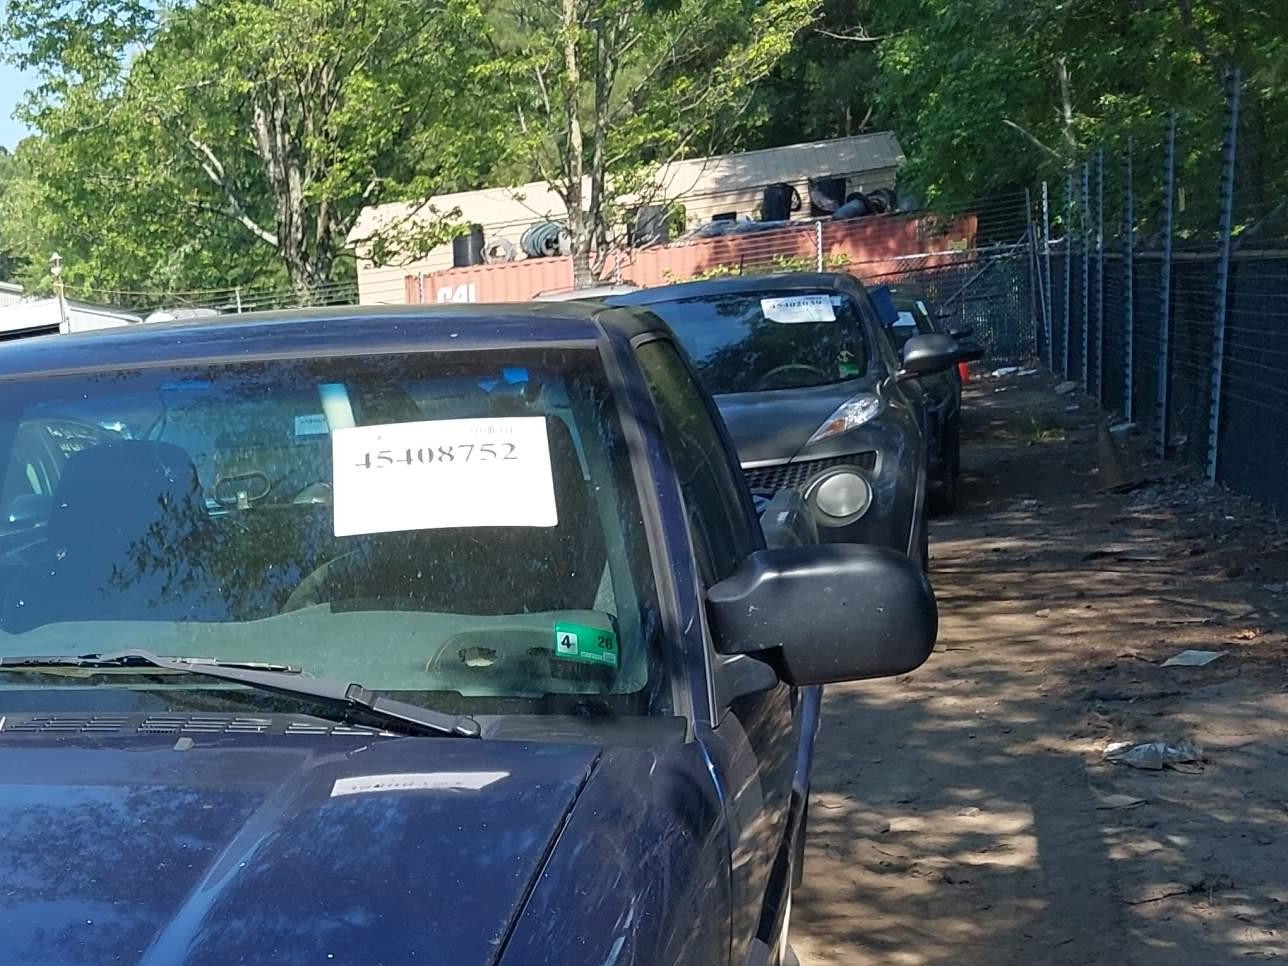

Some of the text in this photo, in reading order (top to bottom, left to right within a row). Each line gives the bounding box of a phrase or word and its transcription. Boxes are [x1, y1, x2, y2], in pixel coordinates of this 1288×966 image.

[355, 442, 519, 469] 45408752
[560, 634, 572, 649] 4
[598, 636, 613, 650] 26
